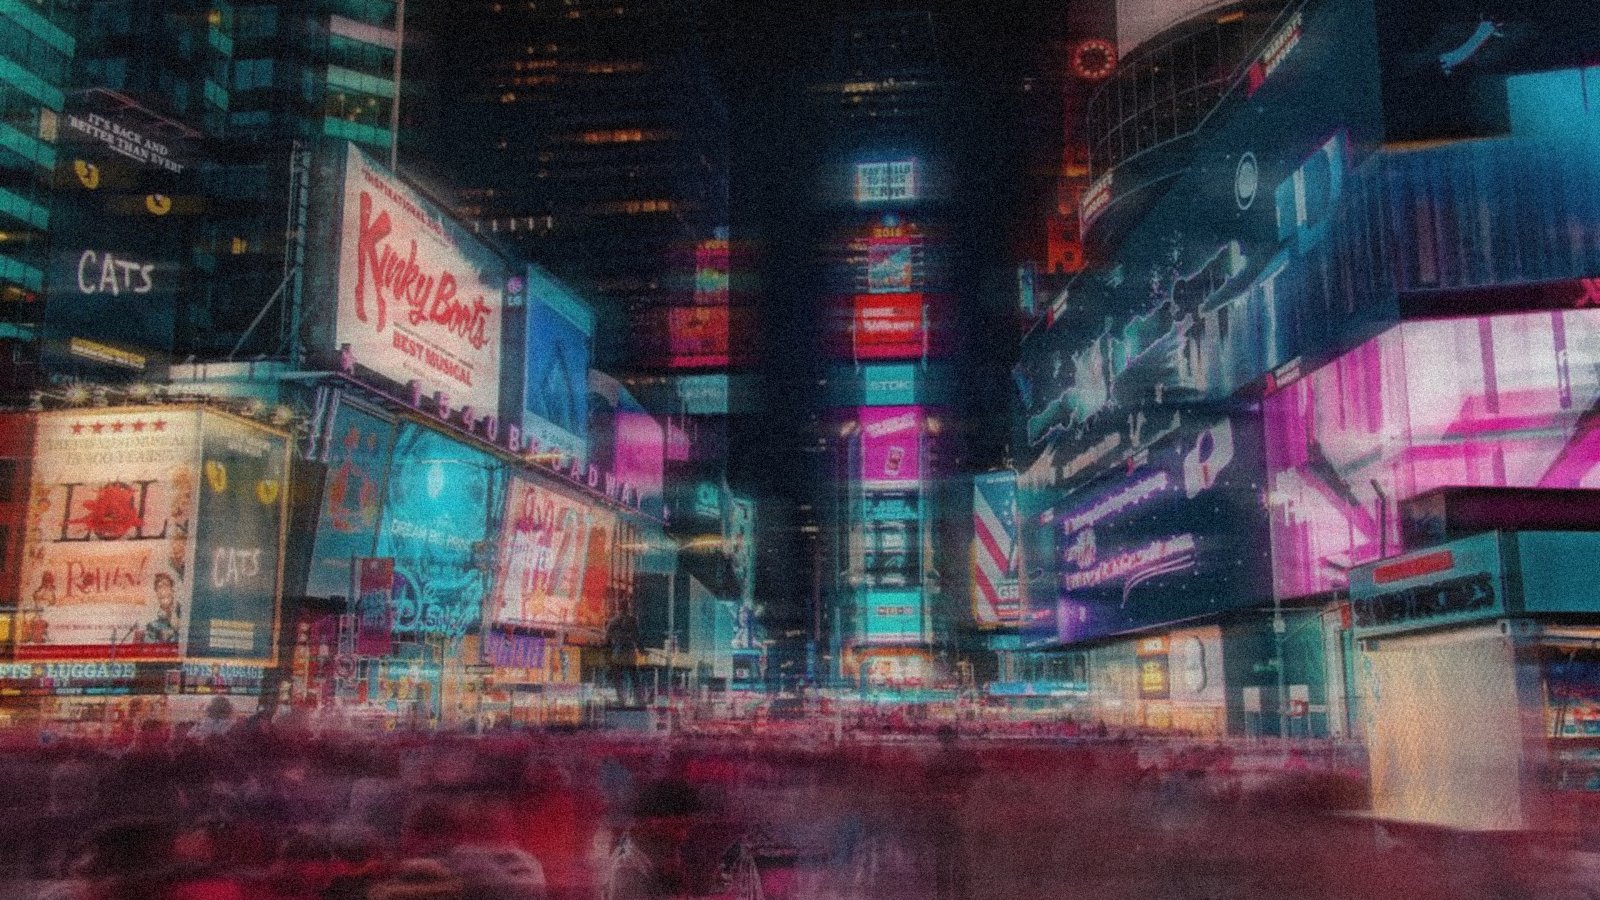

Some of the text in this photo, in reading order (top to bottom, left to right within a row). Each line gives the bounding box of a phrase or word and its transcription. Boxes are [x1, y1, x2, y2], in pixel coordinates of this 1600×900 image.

[89, 113, 168, 155] IT'S BACK AND
[116, 136, 149, 159] THAN
[78, 250, 154, 295] CATS
[355, 191, 434, 332] Kinky
[430, 271, 492, 350] Boots
[393, 331, 424, 359] BEST
[425, 348, 473, 387] MUSICAL
[508, 423, 644, 510] BROADWAY
[213, 548, 260, 587] CATS
[46, 663, 135, 679] LUGGAGE
